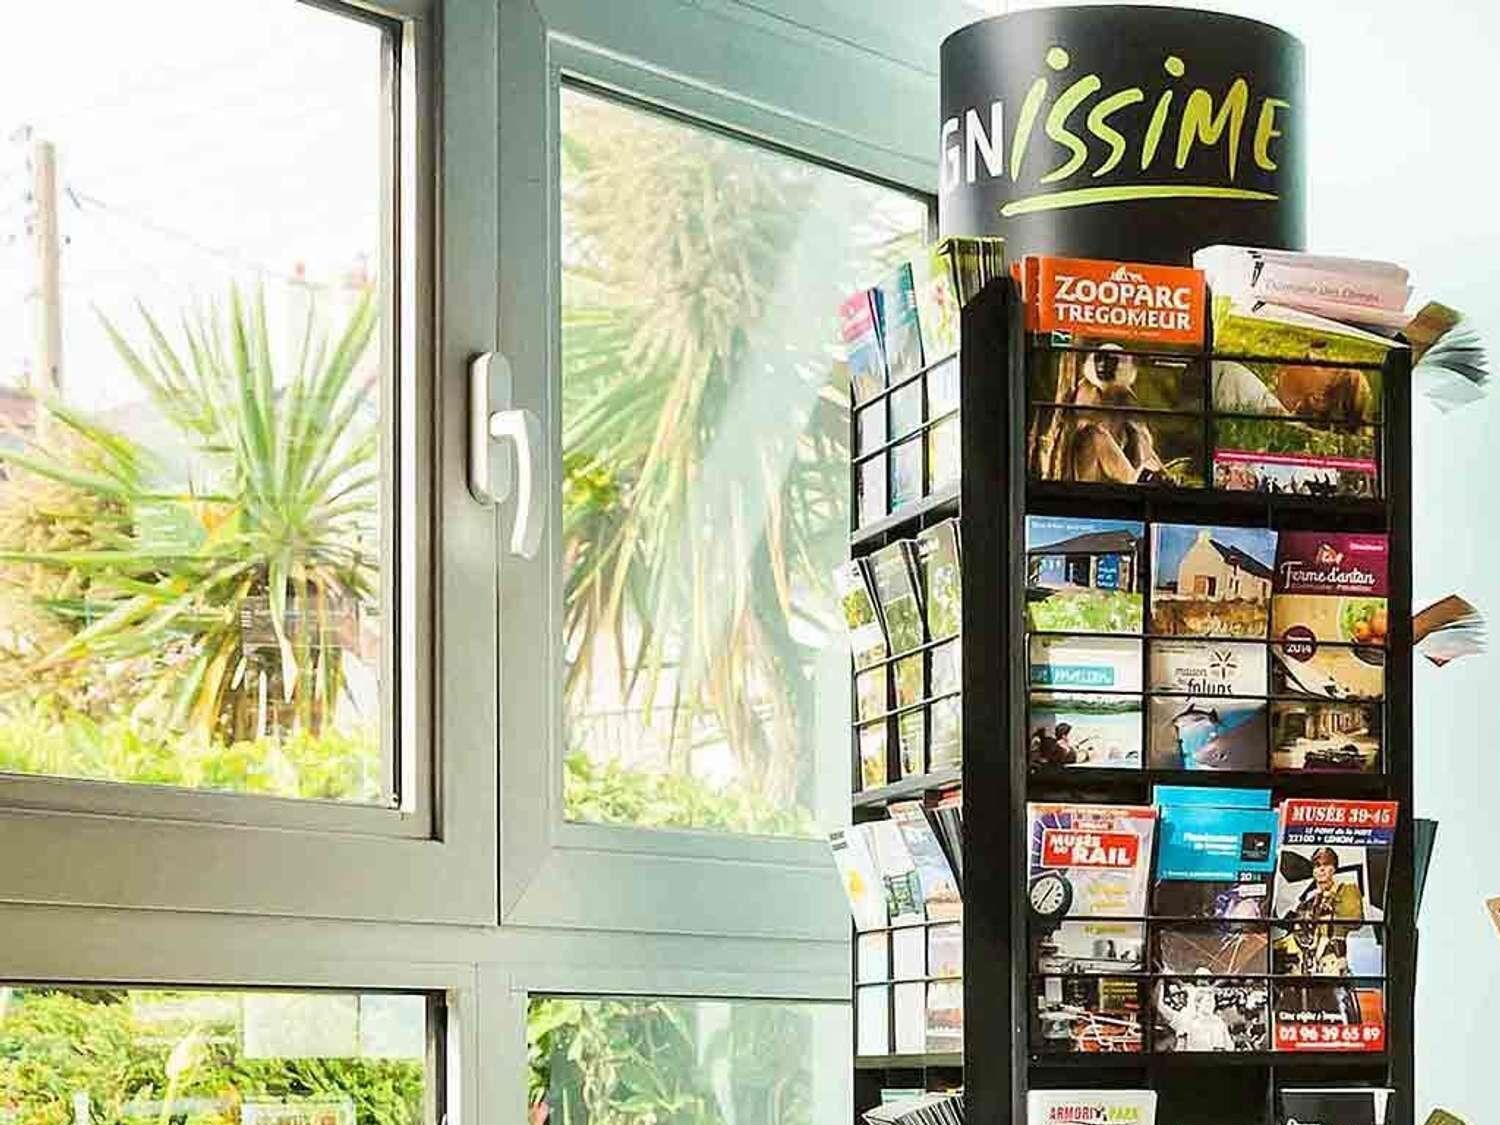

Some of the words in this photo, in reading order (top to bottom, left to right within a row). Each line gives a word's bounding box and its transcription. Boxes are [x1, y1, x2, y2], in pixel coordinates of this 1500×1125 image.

[1054, 274, 1192, 310] ZOOPARC
[1054, 303, 1192, 330] TREGOMEUR
[1073, 846, 1131, 865] RAIL
